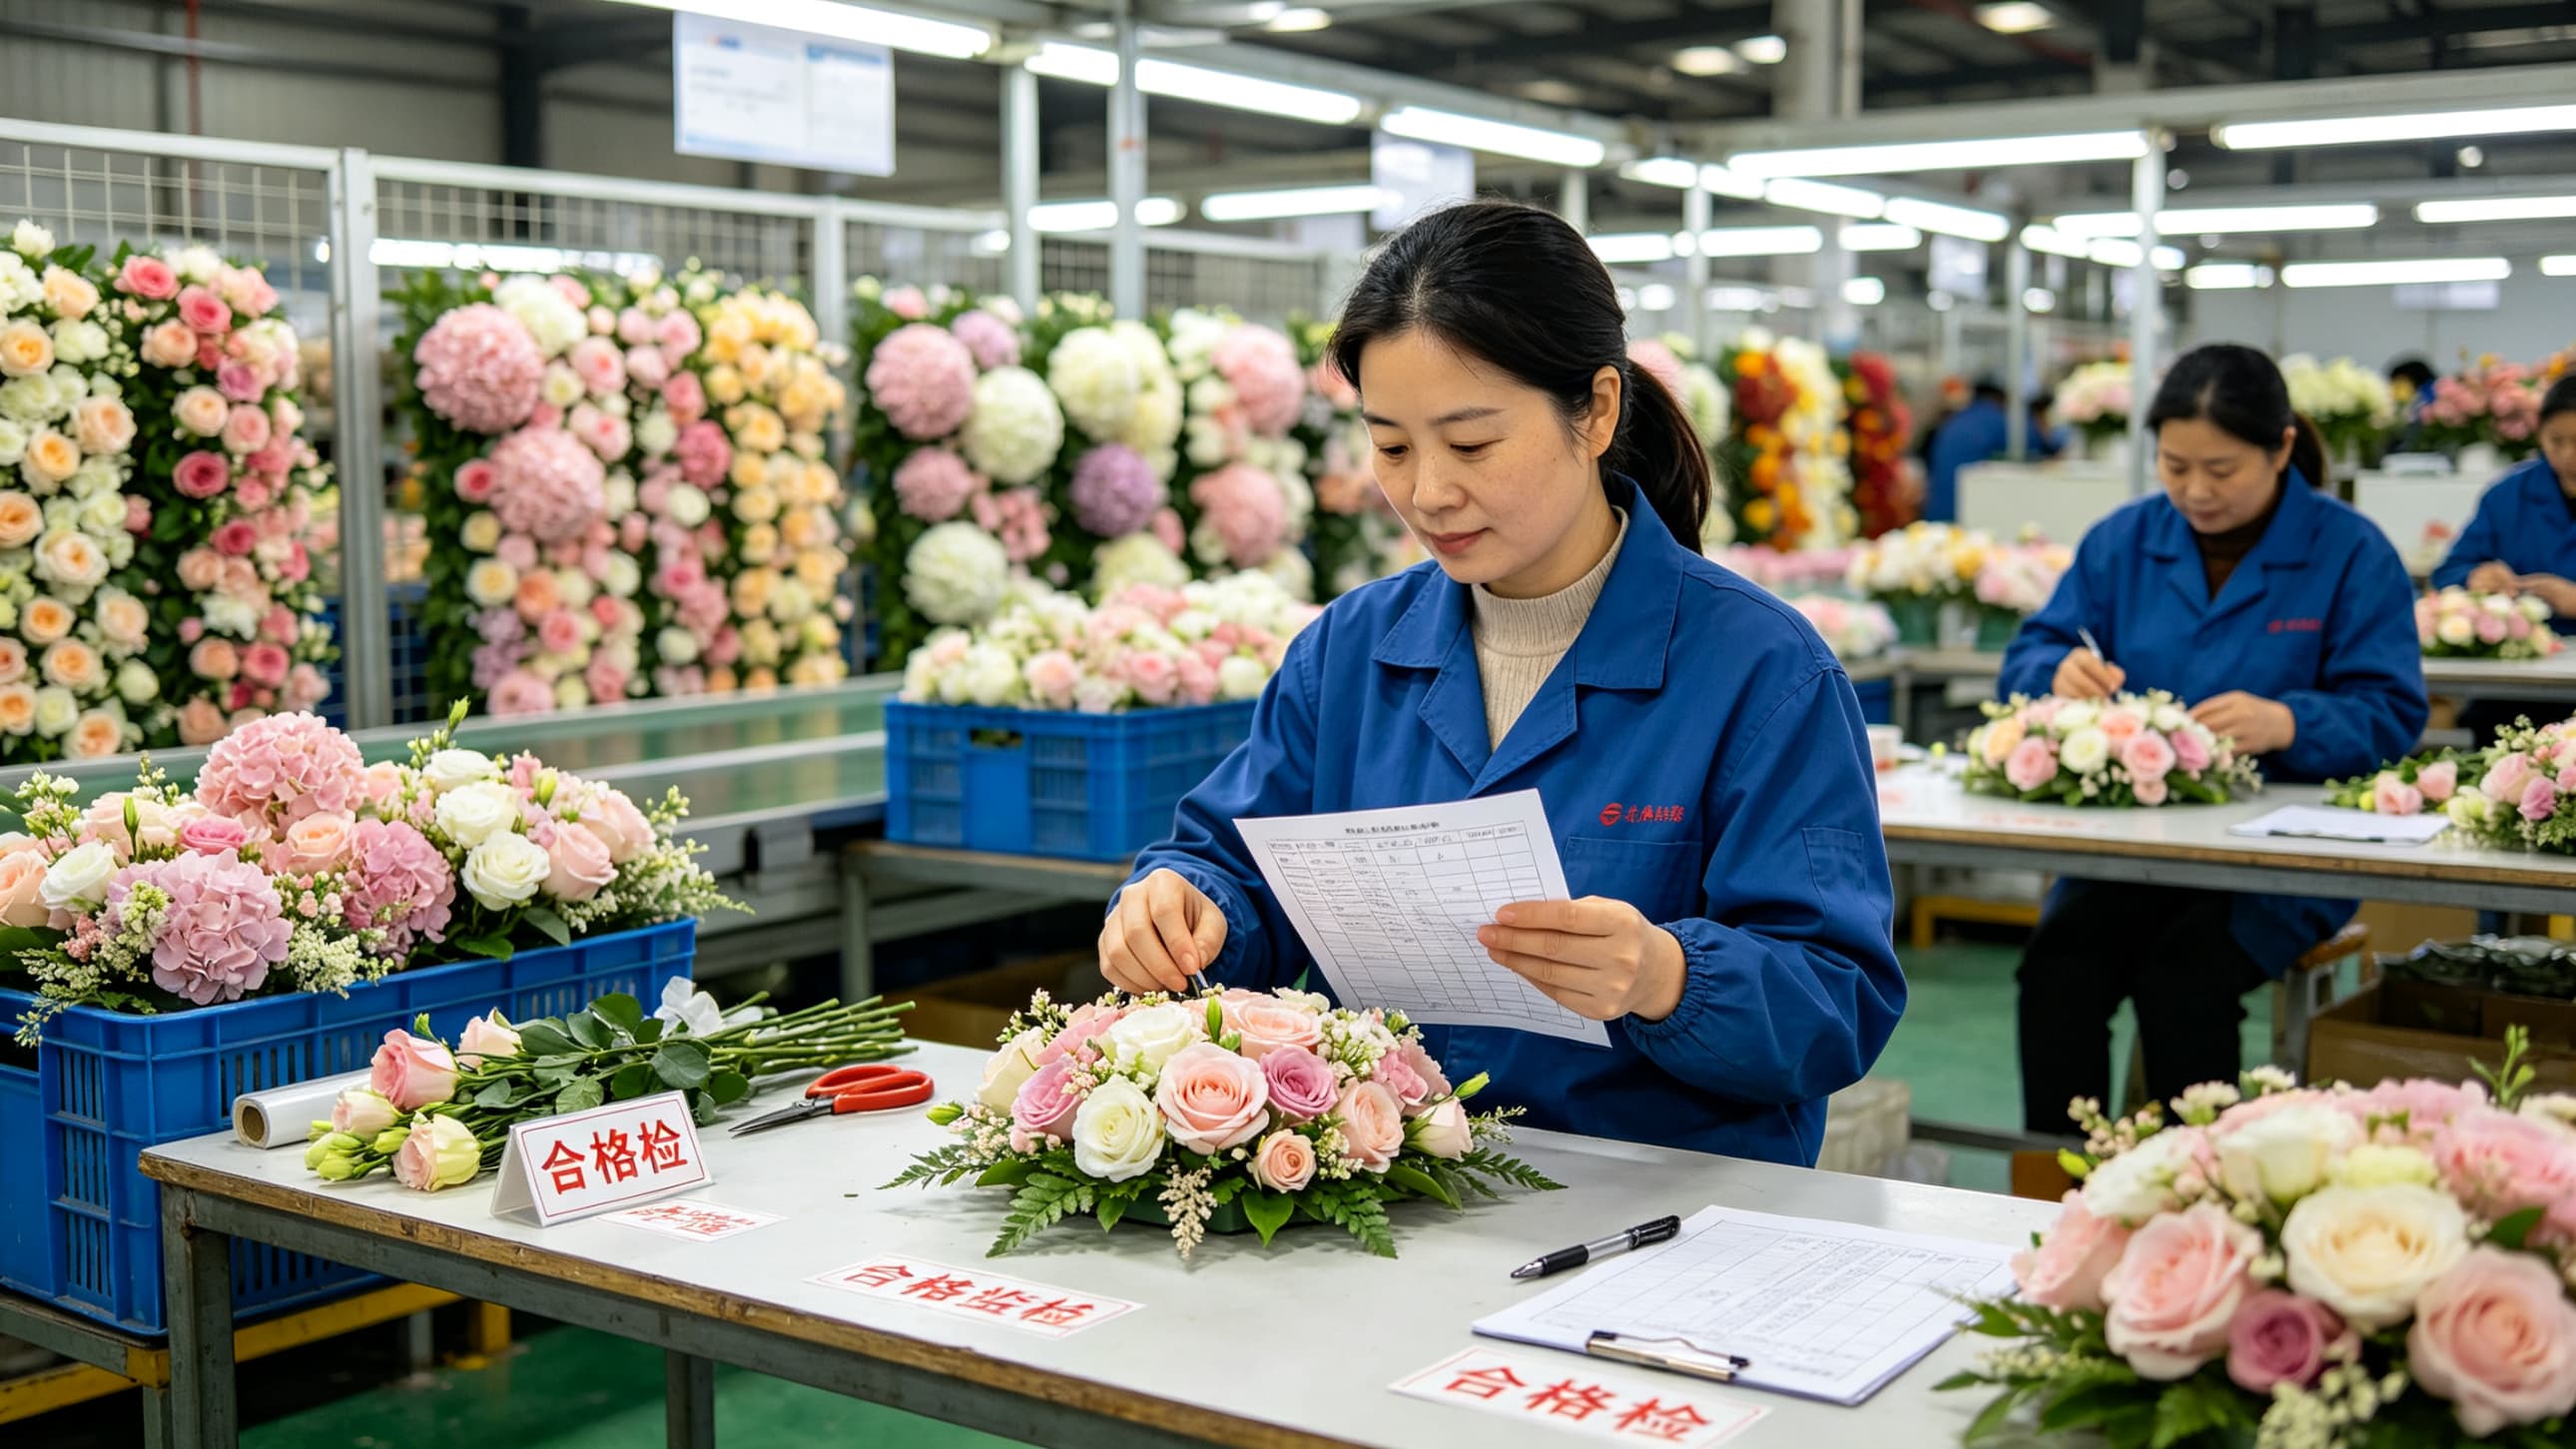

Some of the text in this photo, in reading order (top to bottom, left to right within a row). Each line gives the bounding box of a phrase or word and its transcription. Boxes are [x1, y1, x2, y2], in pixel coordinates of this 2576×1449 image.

[541, 1119, 688, 1195] 合格检
[1445, 1366, 1710, 1442] 合格检
